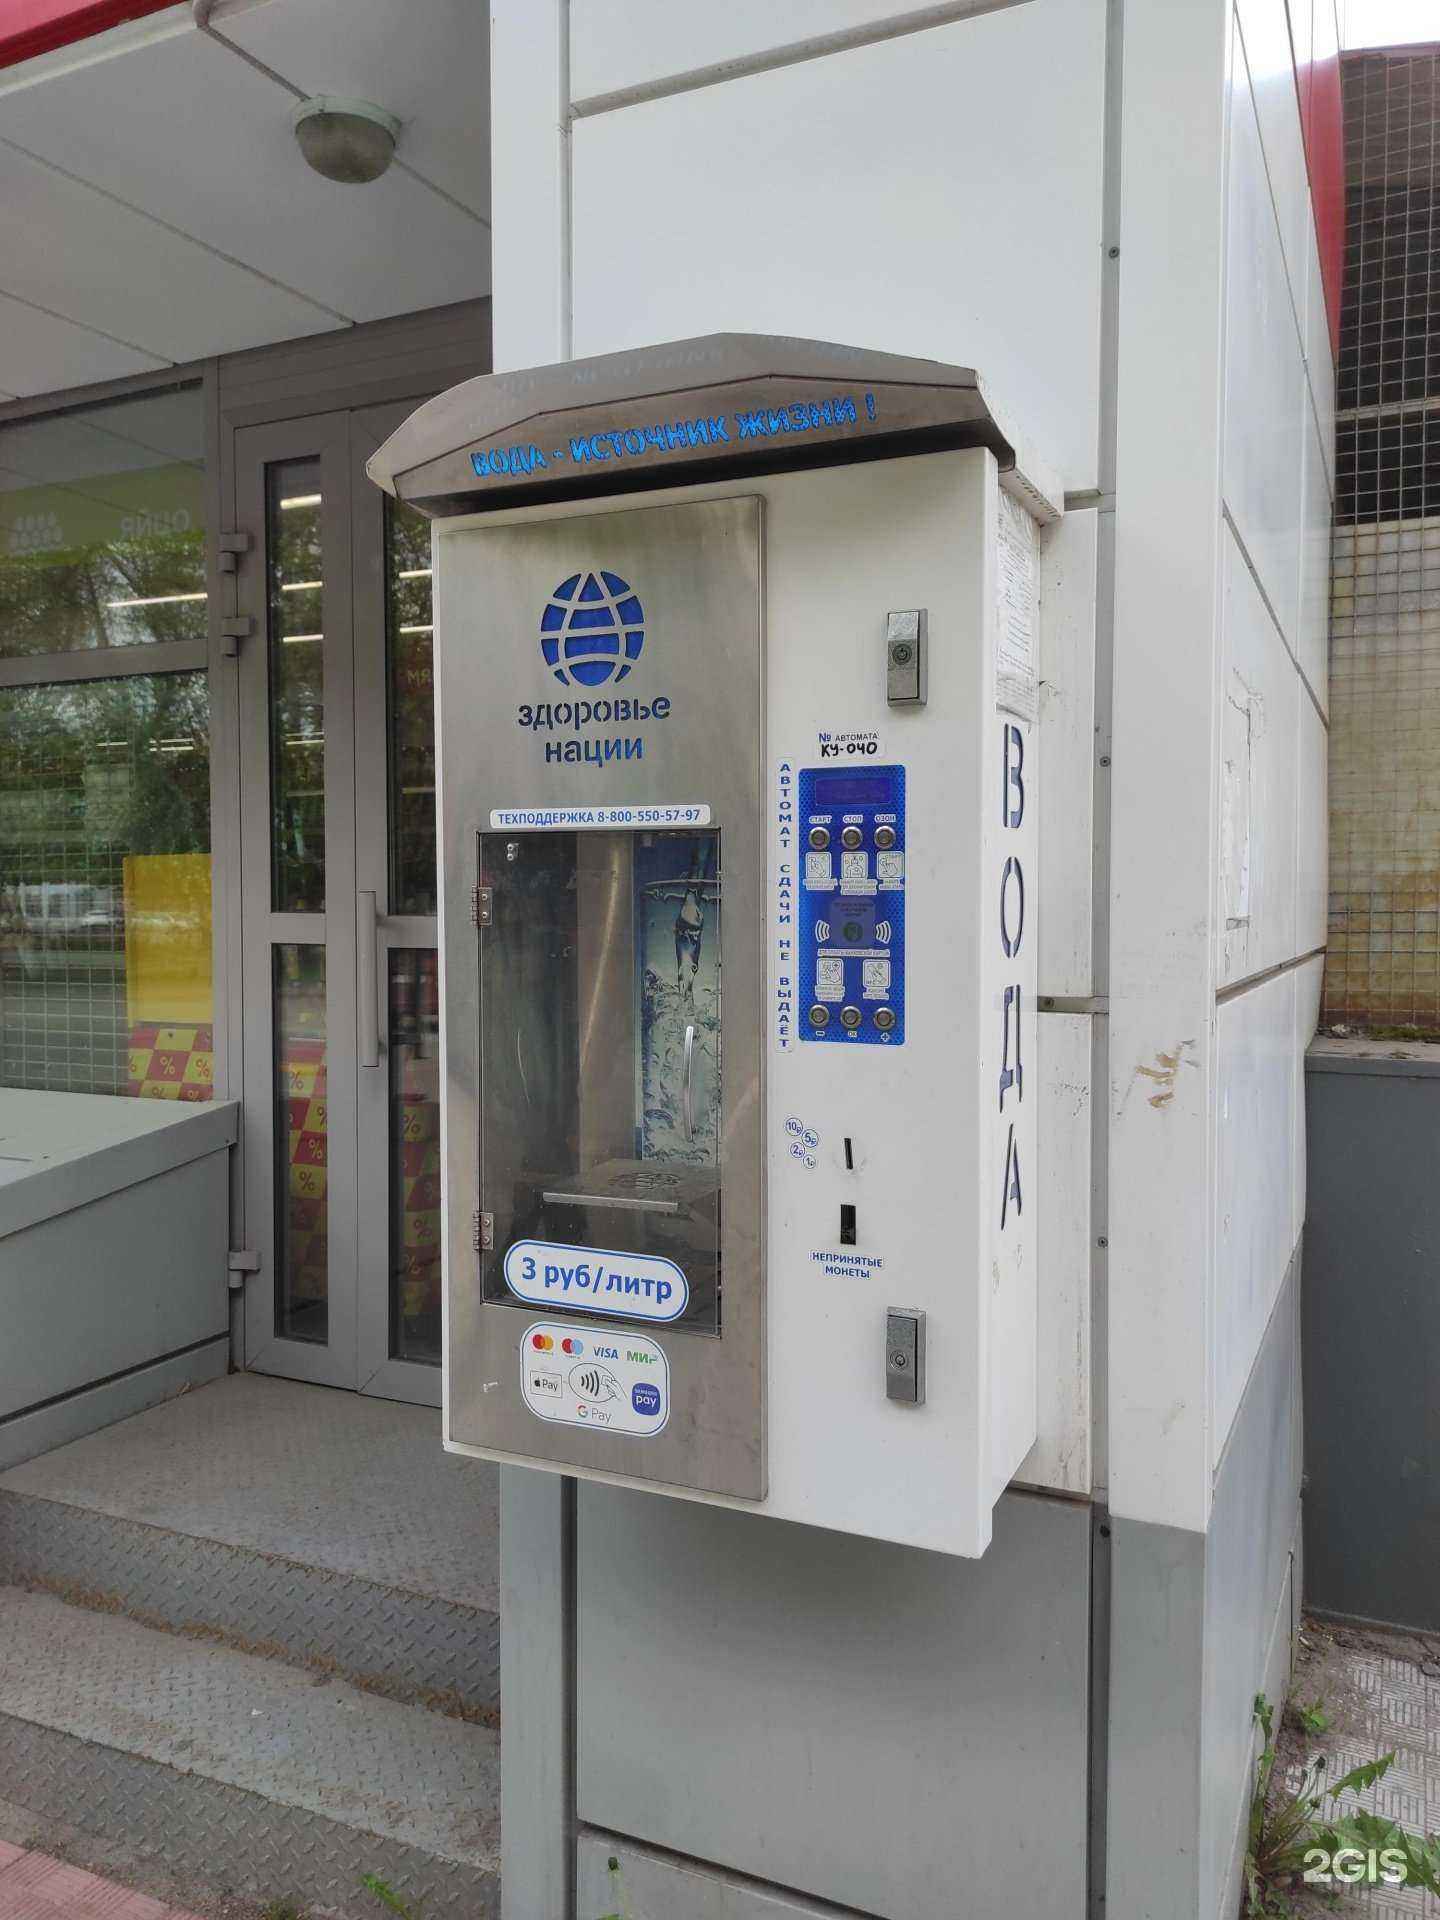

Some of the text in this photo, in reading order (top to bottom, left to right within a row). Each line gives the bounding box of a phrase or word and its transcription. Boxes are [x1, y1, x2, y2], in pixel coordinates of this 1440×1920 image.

[470, 443, 548, 477] ВОДА
[569, 415, 729, 463] ИСТОЧНИК
[734, 395, 858, 440] ЖИЗНИ
[518, 696, 671, 731] здоровье
[835, 732, 878, 742] АВТОМАТА
[545, 737, 643, 768] нации
[779, 763, 791, 848] АВТОМАТ
[498, 809, 701, 826] ТЕХПОДДЕРЖКА 8-800-550-57-97
[779, 864, 791, 923] СДАЧИ
[779, 940, 791, 961] НЕ
[1000, 723, 1024, 1230] ВОДА
[812, 1252, 883, 1267] НЕПРИНЯТЫЕ
[521, 1257, 672, 1304] 3 руб/литр
[825, 1265, 870, 1278] МОНЕТЫ
[593, 1346, 619, 1360] VISA
[542, 1379, 559, 1392] Pay
[636, 1395, 657, 1408] pay
[591, 1408, 612, 1423] Pay
